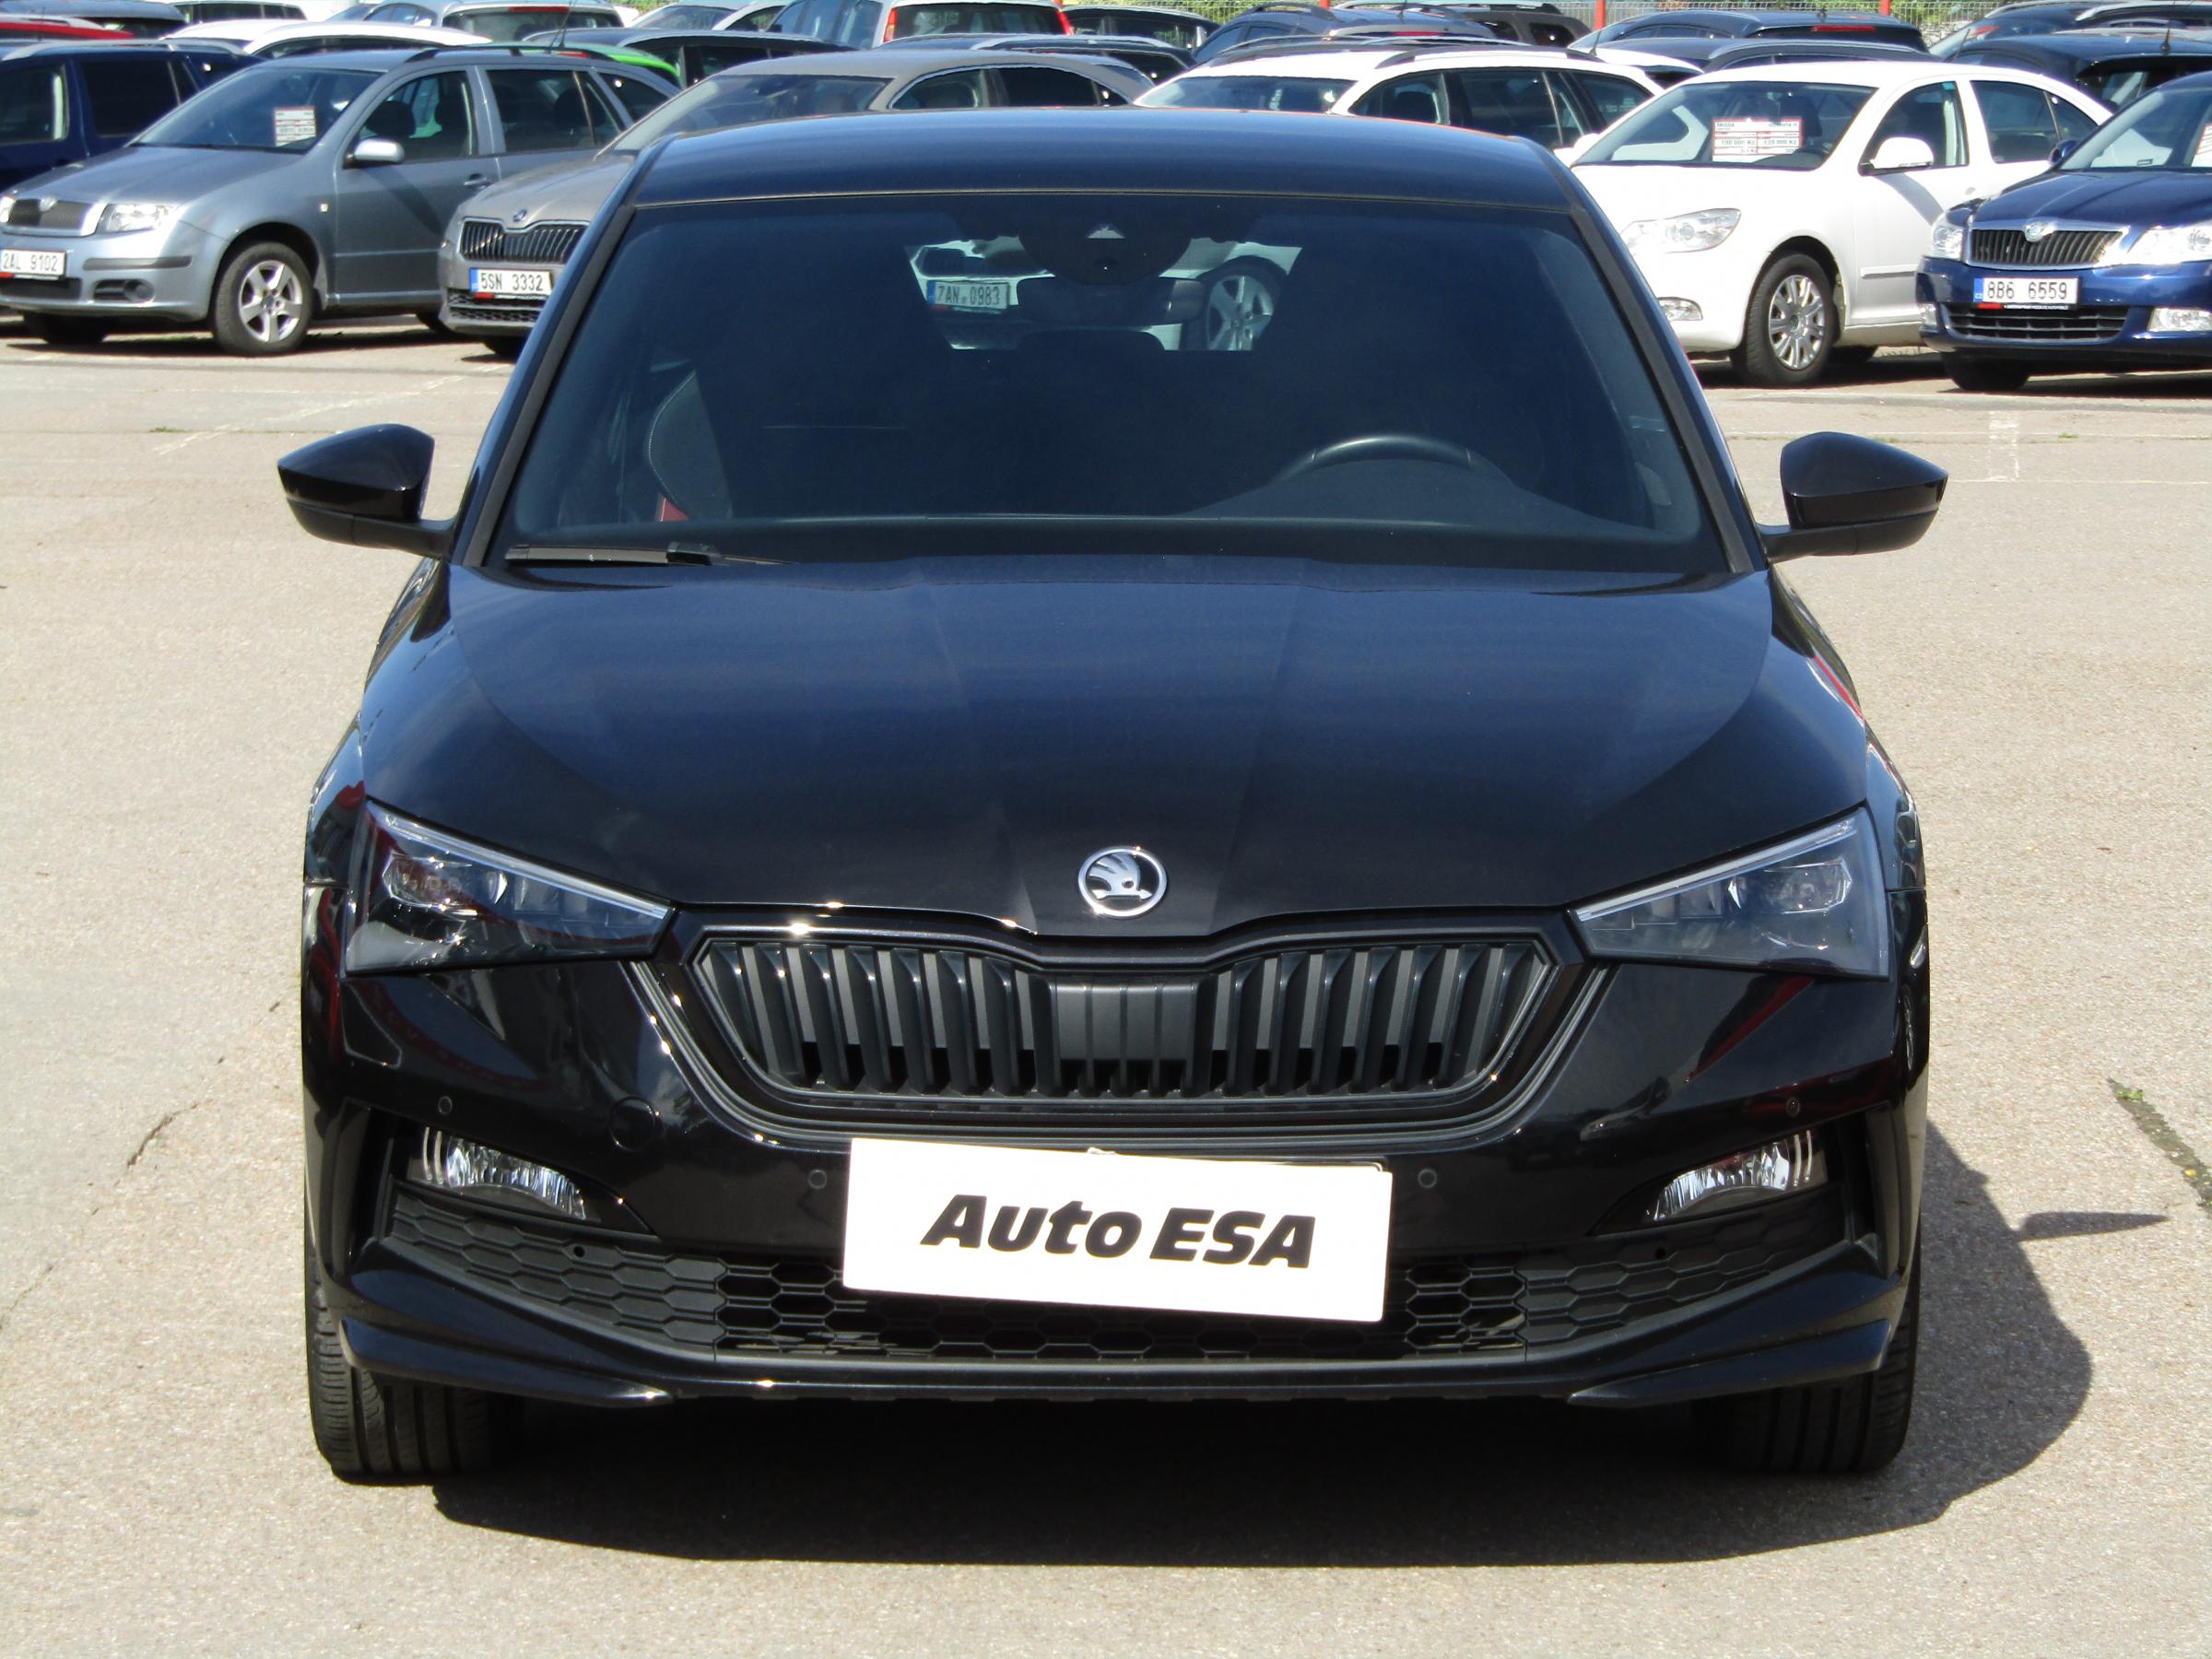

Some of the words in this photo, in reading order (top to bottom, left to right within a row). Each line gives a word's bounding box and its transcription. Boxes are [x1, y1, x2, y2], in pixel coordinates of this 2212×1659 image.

[30, 253, 58, 272] 9102
[480, 272, 502, 290] 5SN
[512, 273, 544, 291] 3332
[2028, 281, 2067, 300] 6559
[937, 286, 959, 303] 7AN
[970, 286, 1000, 305] 0983
[920, 1194, 1143, 1258] Auto
[1149, 1206, 1316, 1269] ESA
